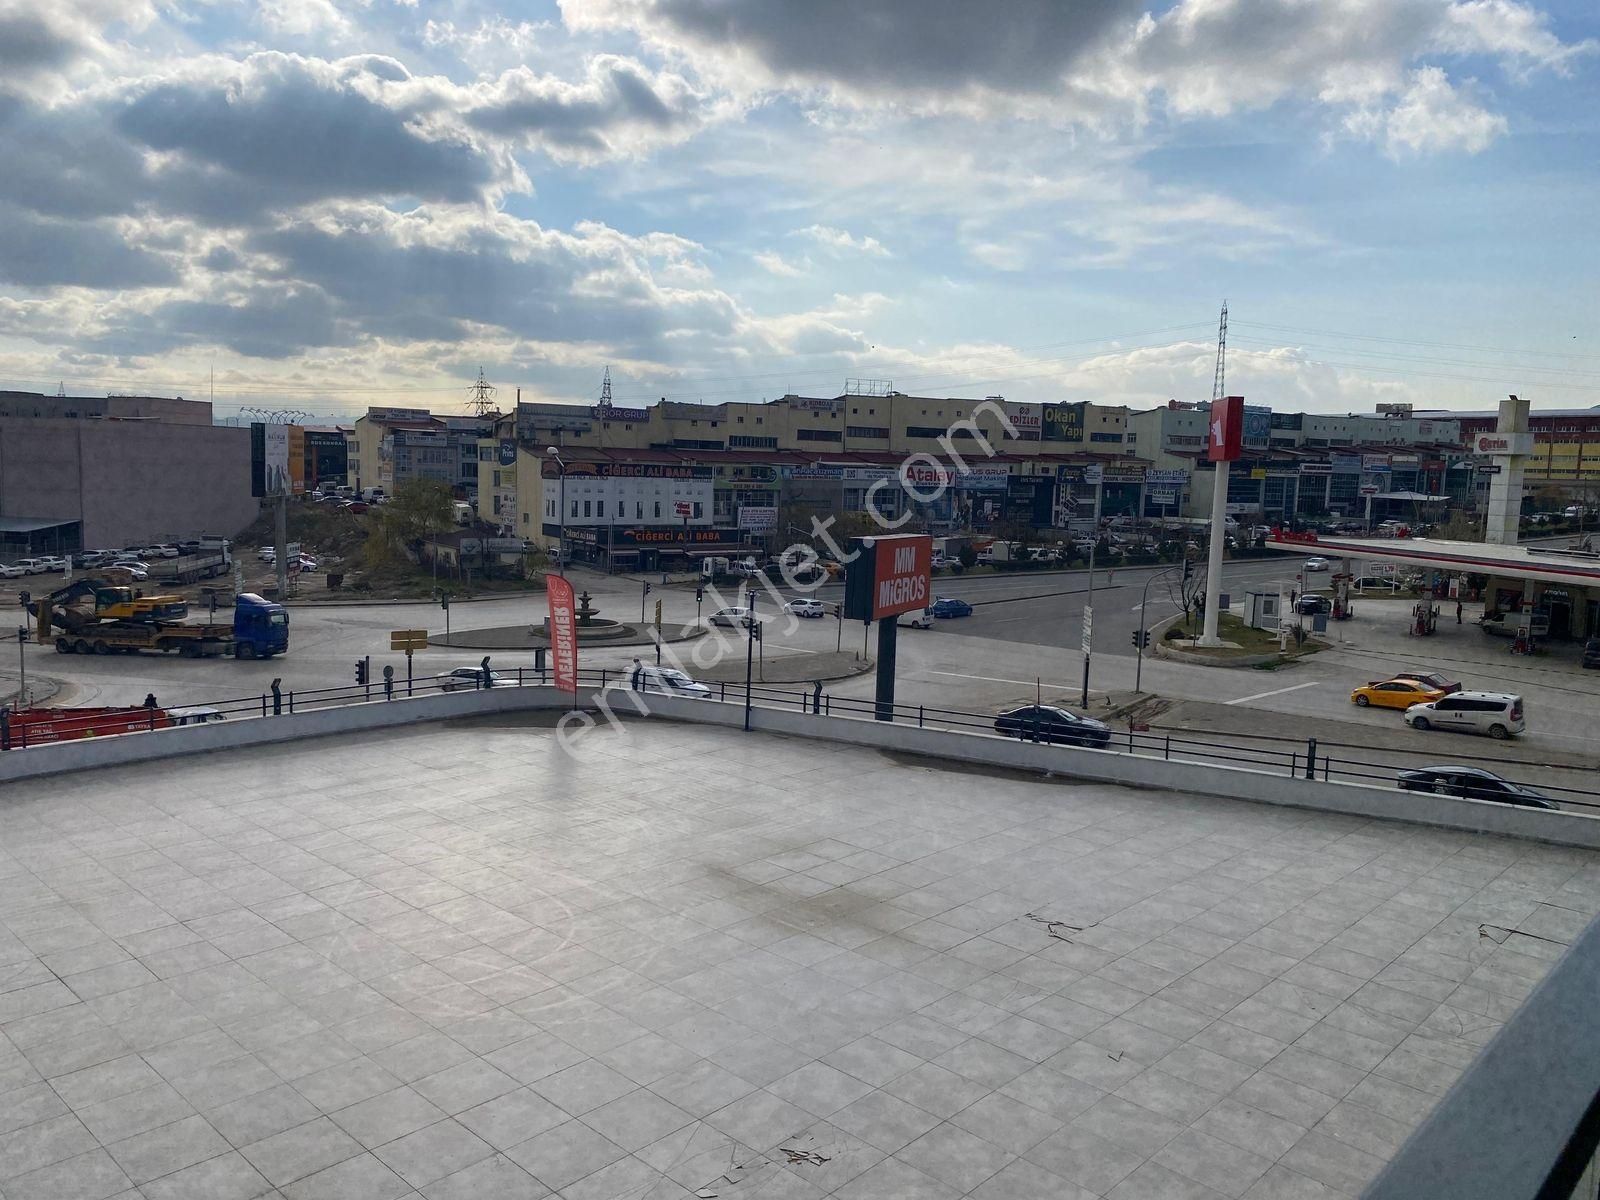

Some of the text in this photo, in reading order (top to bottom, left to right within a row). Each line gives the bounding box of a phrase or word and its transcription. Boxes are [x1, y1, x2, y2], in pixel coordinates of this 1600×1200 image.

[624, 410, 649, 419] GRUP
[1045, 409, 1077, 423] Okan
[1061, 424, 1083, 437] Yapı
[602, 463, 645, 477] CİĞERCİ
[647, 464, 663, 477] ALİ
[665, 466, 693, 479] BABA
[907, 466, 954, 485] Atalay
[636, 530, 721, 541] CİĞERCİ Aİ BABA
[894, 546, 916, 574] MM
